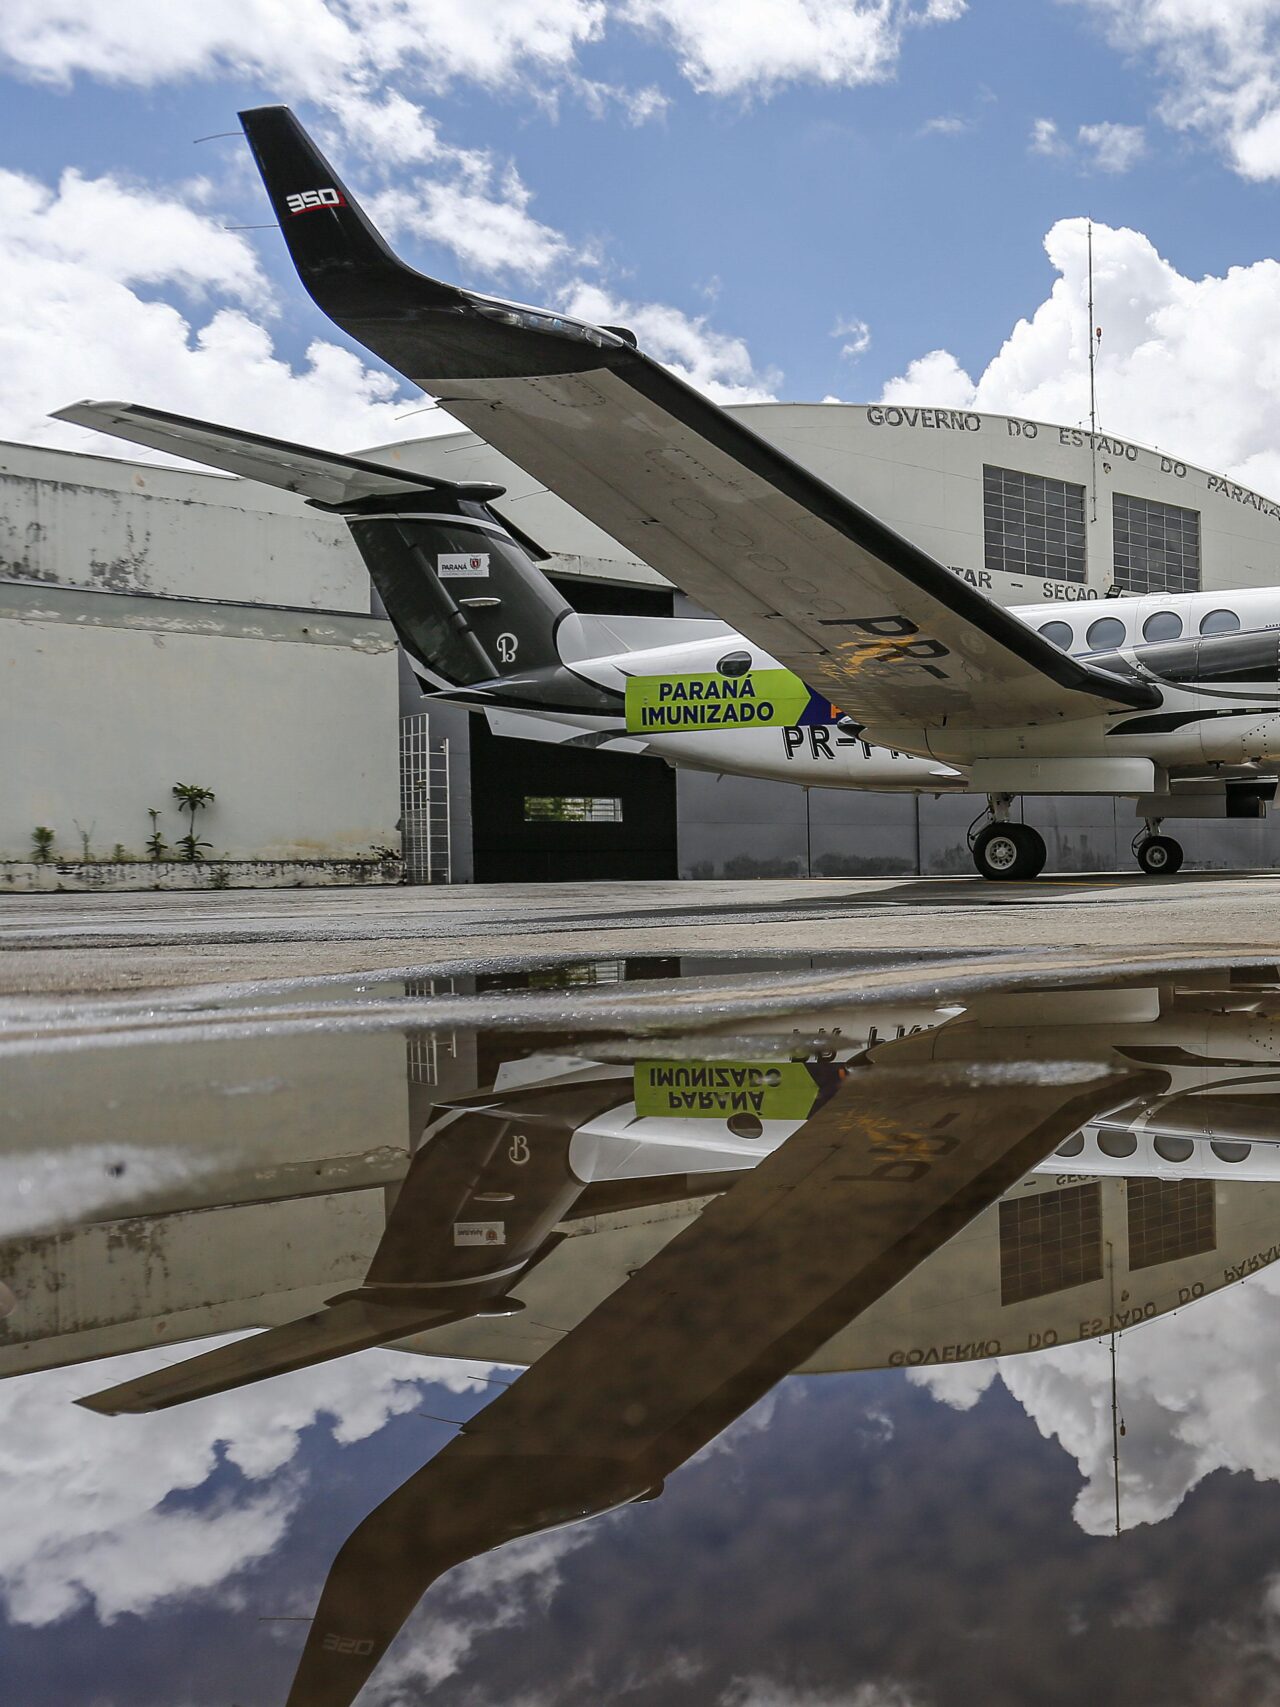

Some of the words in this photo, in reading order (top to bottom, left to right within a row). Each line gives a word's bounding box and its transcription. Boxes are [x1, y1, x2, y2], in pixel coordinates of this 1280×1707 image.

[867, 406, 981, 432] GOVERNO
[1007, 418, 1038, 439] DO
[1059, 427, 1138, 462] ESTADO
[1160, 456, 1187, 479] DO
[947, 565, 993, 589] TAR
[659, 674, 756, 701] PARANÁ
[641, 701, 775, 726] IMUNIZADO
